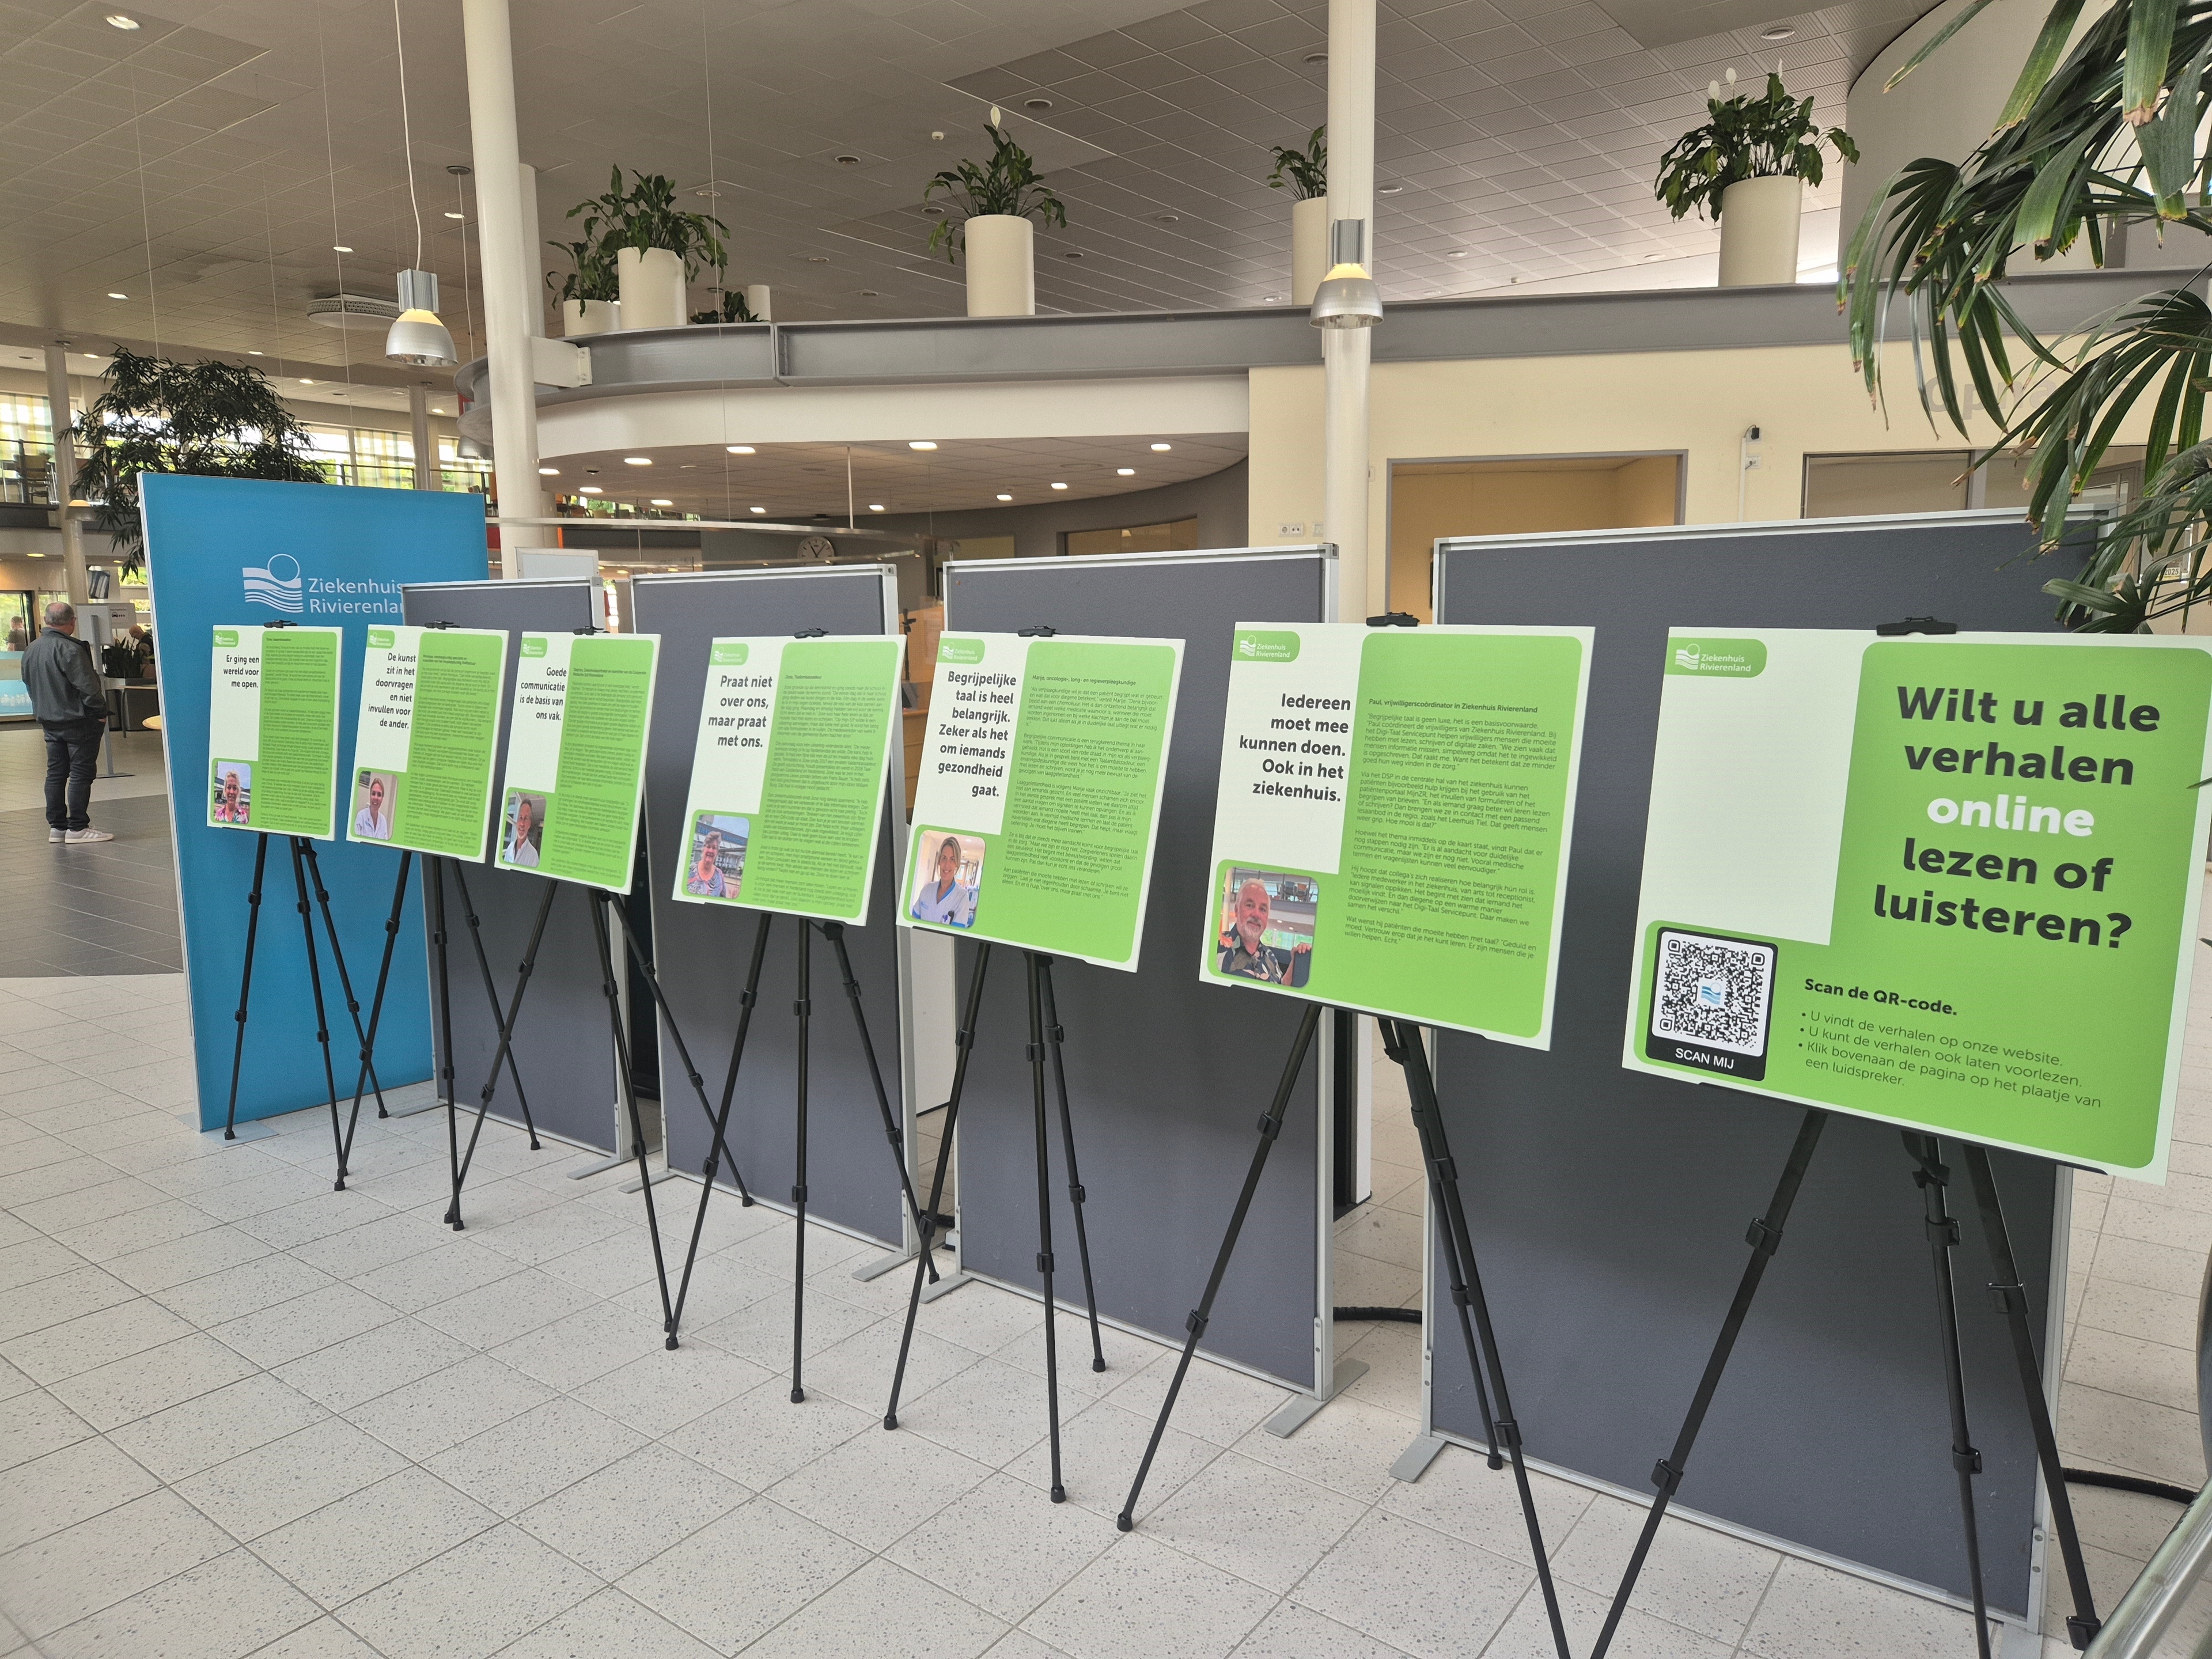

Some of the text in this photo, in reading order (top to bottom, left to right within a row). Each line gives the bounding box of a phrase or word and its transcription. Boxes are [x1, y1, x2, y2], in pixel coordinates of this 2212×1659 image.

[1924, 375, 2137, 420] Opna
[308, 578, 402, 595] Ziekenhuis
[310, 598, 403, 615] Rivierenla
[226, 654, 232, 662] Er
[233, 657, 247, 665] ging
[388, 652, 396, 661] De
[397, 653, 416, 662] kunst
[1701, 654, 1744, 662] Ziekenhuis
[396, 666, 402, 675] in
[403, 667, 415, 676] het
[546, 666, 567, 677] Goede
[1700, 662, 1751, 672] Rivierenland
[375, 679, 413, 691] doorvragen
[520, 681, 565, 691] communicatie
[720, 675, 748, 687] Praat
[751, 675, 772, 688] niet
[948, 671, 1016, 688] Begrijpelijke
[399, 694, 412, 702] niet
[526, 695, 533, 704] de
[535, 695, 550, 705] basis
[720, 698, 768, 709] over ons,
[956, 690, 1013, 704] taal is heel
[1281, 693, 1351, 710] Iedereen
[368, 705, 394, 714] invullen
[1384, 699, 1453, 708] vrijwilligerscoördinator
[1461, 703, 1495, 711] Ziekenhuis
[1497, 704, 1538, 713] Rivierenland
[1897, 686, 2160, 732] Wilt u alle
[548, 711, 561, 720] vak.
[708, 716, 767, 730] maar praat
[952, 707, 1010, 725] belangrijk.
[379, 718, 409, 729] de ander.
[1271, 718, 1349, 733] moet mee
[938, 724, 1008, 741] Zeker als het
[717, 735, 763, 747] met ons.
[1239, 734, 1345, 756] kunnen doen.
[940, 743, 1005, 759] om iemands
[938, 762, 1003, 777] gezondheid
[1262, 759, 1344, 779] Ook in het
[1904, 741, 2133, 785] verhalen
[972, 785, 999, 797] gaat.
[1252, 781, 1340, 802] ziekenhuis.
[1359, 779, 1387, 787] patiënten
[1388, 781, 1423, 791] bijvoorbeeld
[1439, 786, 1459, 794] krijgen
[1504, 783, 1528, 791] kunnen
[1927, 794, 2094, 836] online
[1355, 828, 1377, 836] Hoewel
[1408, 836, 1437, 844] inmiddels
[1508, 846, 1522, 854] Paul
[1903, 837, 2114, 892] lezen of
[1874, 884, 2132, 948] luisteren?
[1804, 978, 1957, 1015] Scan de QR-code.
[1810, 1010, 2062, 1066] U vindt de verhalen op onze website.
[1675, 1048, 1734, 1069] SCAN MIJ
[1809, 1025, 2081, 1087] U kunt de verhalen ook laten voorlezen.
[1805, 1059, 1904, 1086] een luidspreker.
[1807, 1041, 2101, 1108] Klik bovenaan de pagina op het plaatje van
